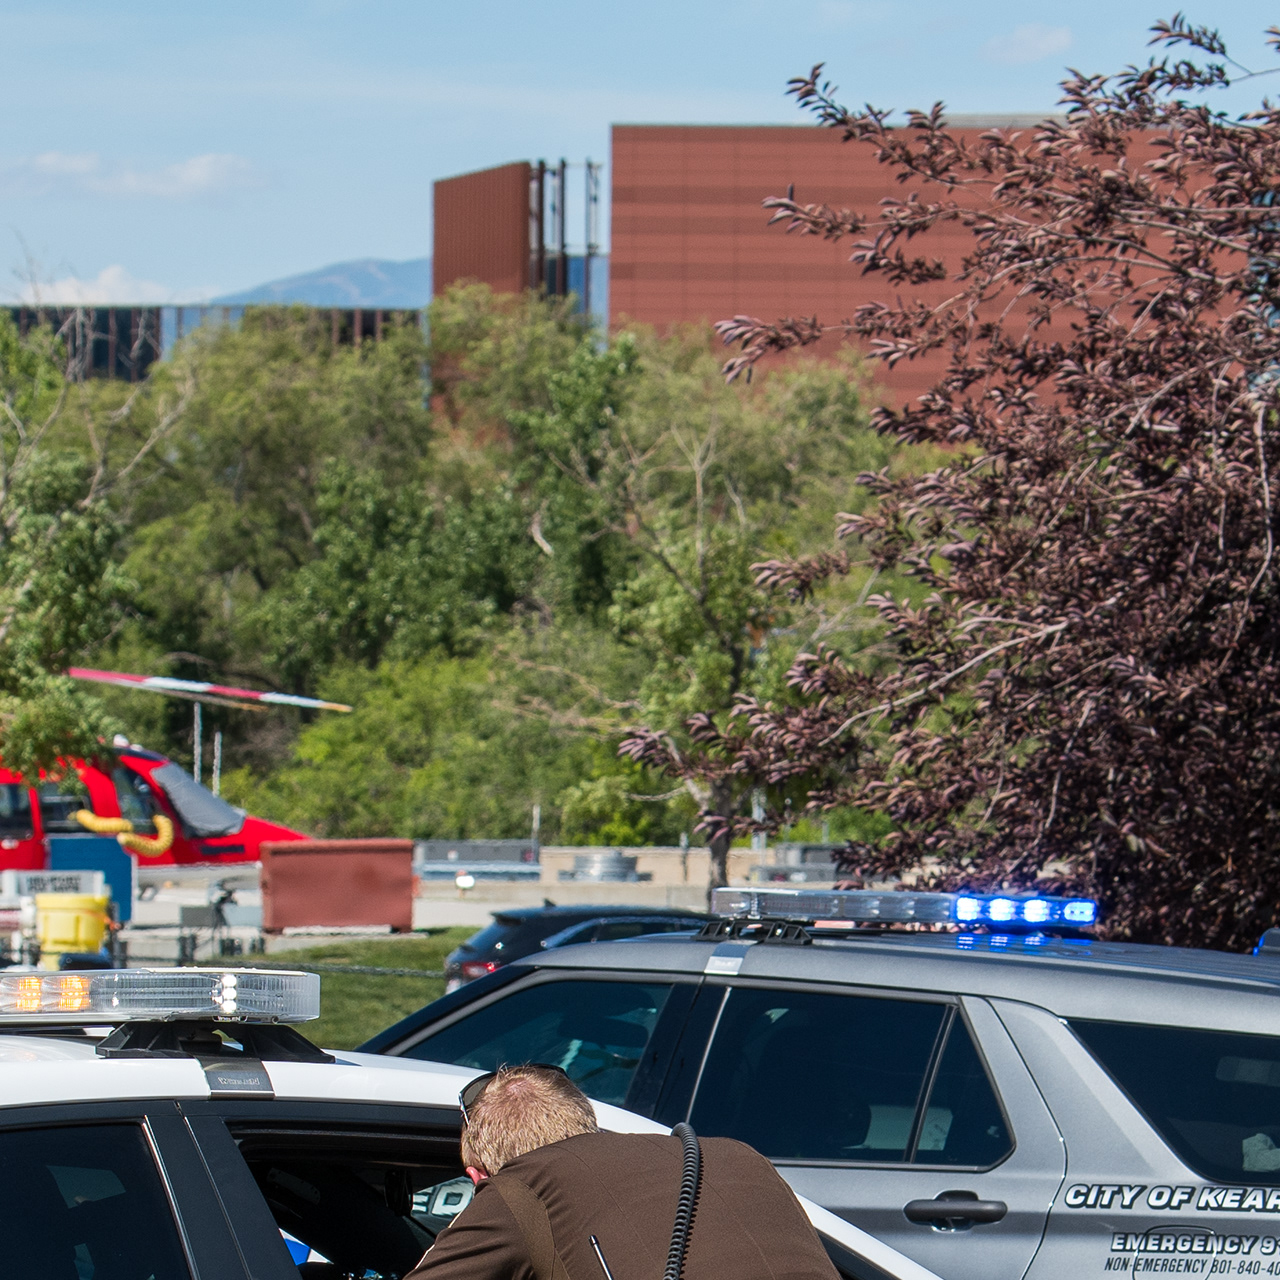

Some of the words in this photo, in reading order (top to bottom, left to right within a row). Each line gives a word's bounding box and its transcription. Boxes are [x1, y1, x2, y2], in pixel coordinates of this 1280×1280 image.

[1065, 1184, 1145, 1210] CITY
[1147, 1186, 1195, 1210] OF
[1110, 1232, 1258, 1255] EMERGENCY
[1104, 1257, 1208, 1274] NON-EMERGENCY
